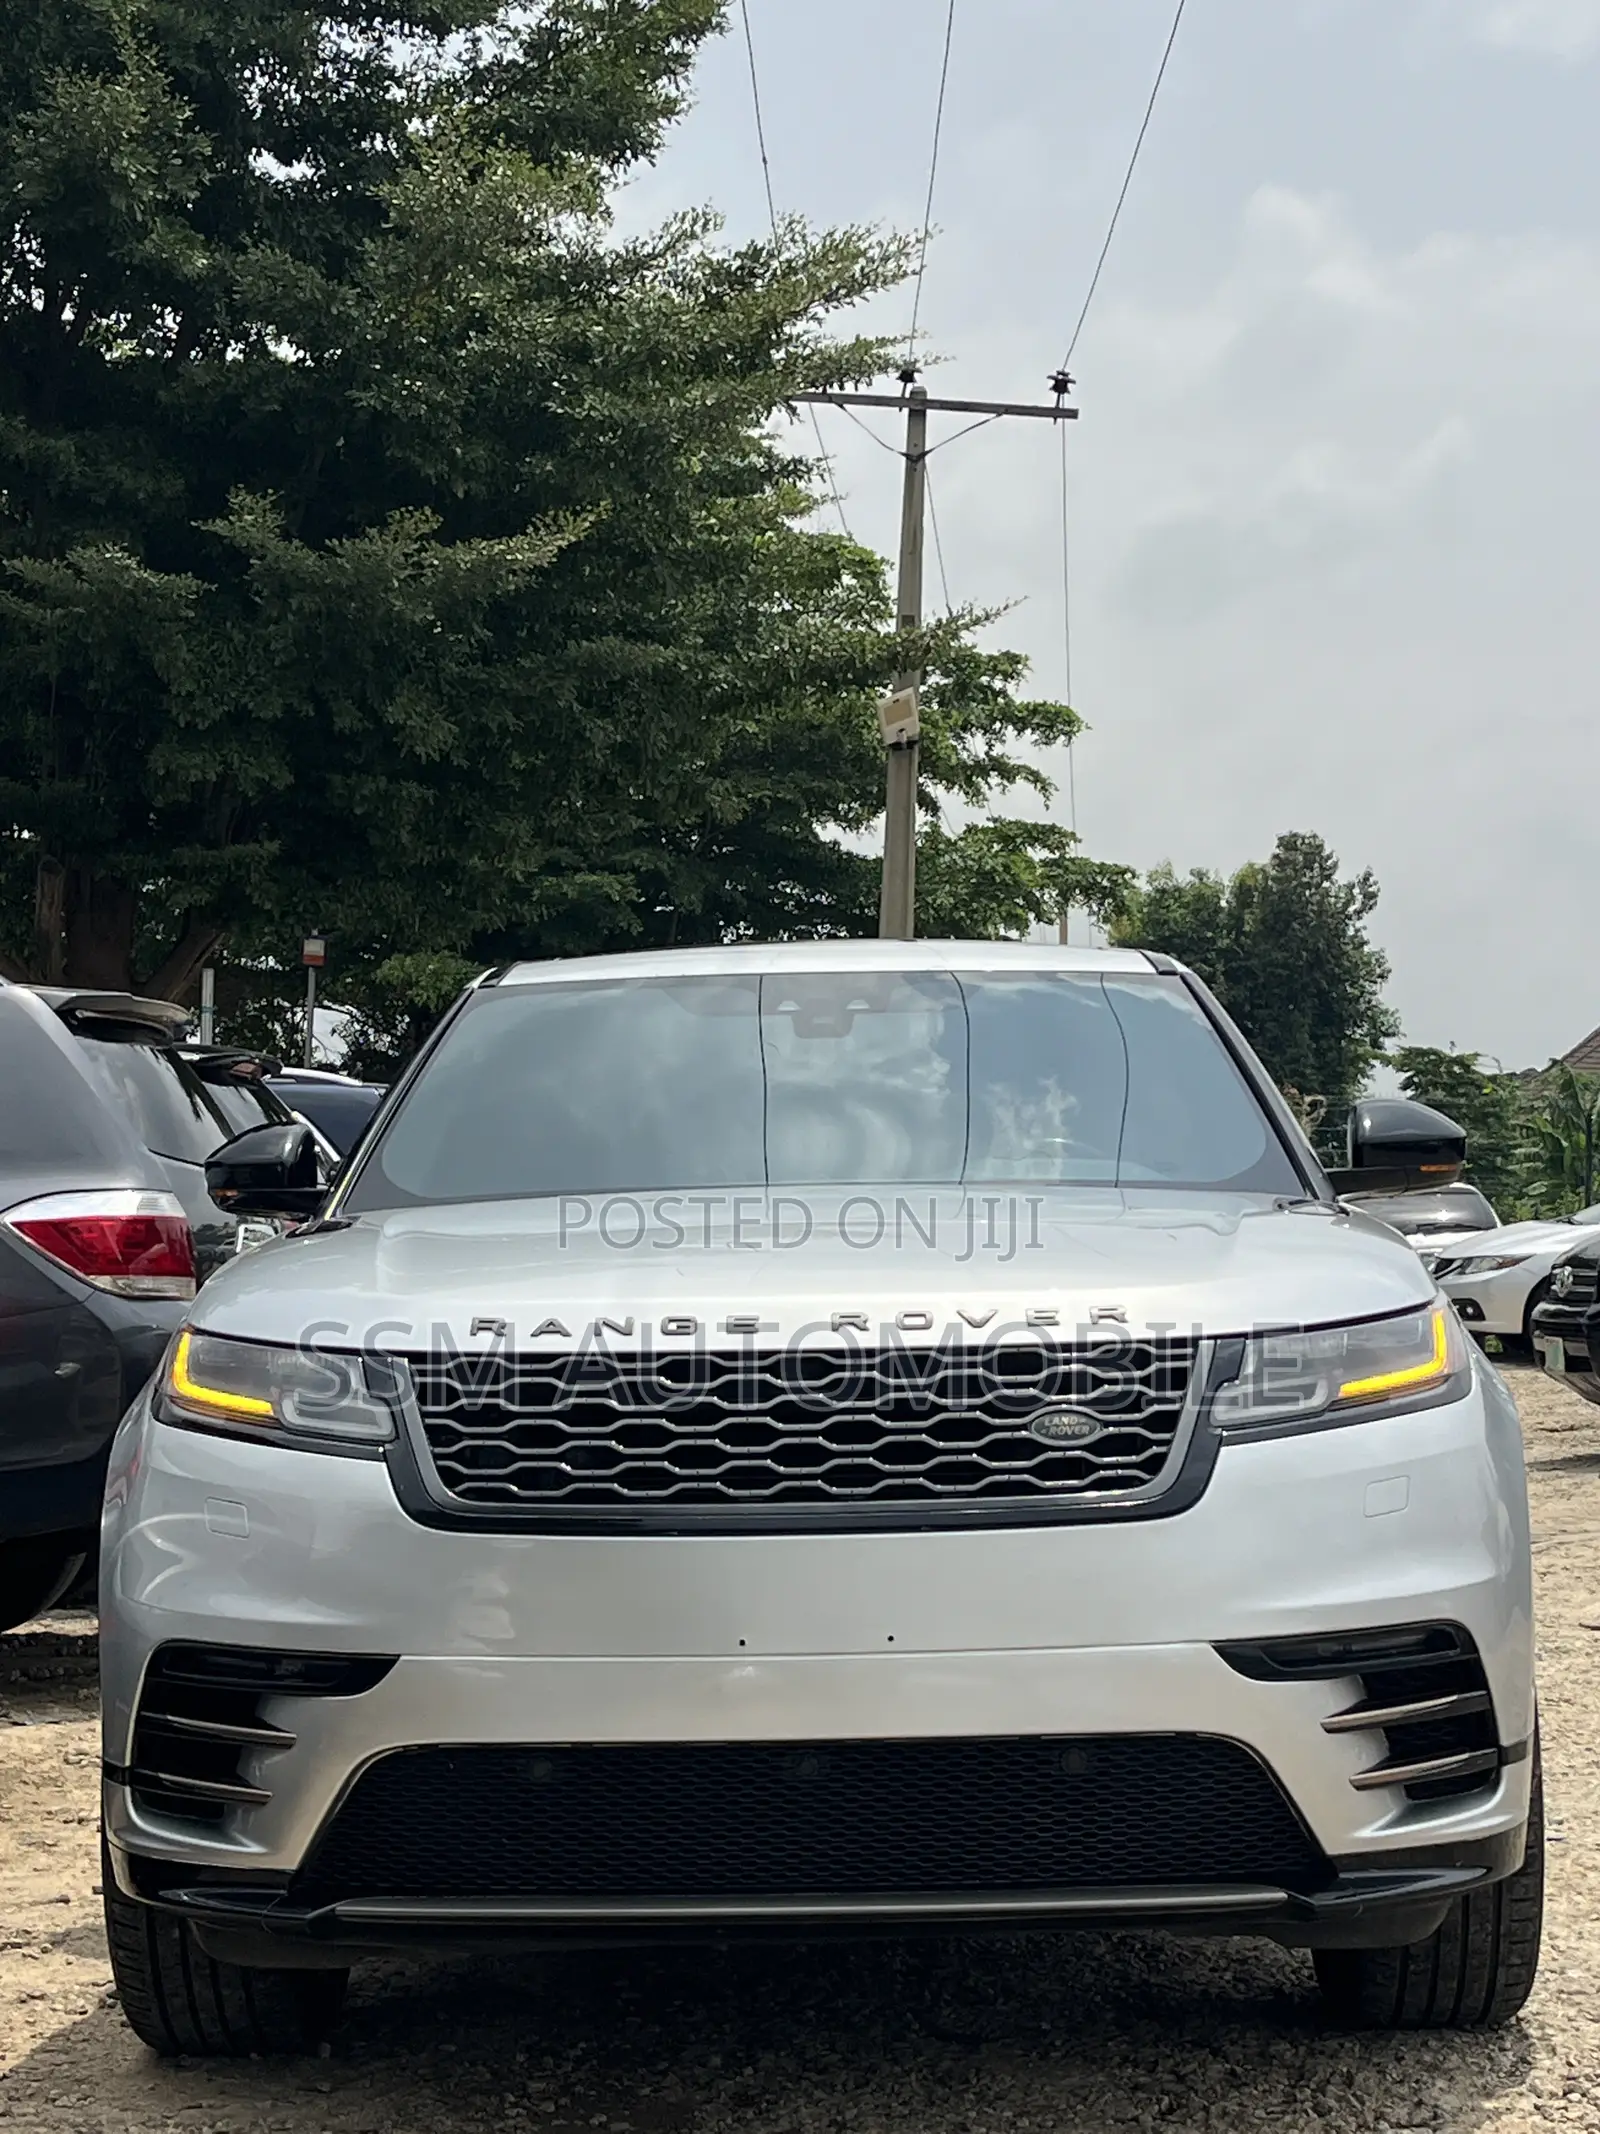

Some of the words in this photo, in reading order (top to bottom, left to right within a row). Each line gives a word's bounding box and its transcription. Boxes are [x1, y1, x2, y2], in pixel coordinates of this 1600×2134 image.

[470, 1316, 761, 1337] RANGE
[831, 1306, 1129, 1331] ROVER
[1044, 1416, 1078, 1426] LAND
[1048, 1425, 1090, 1436] ROVER
